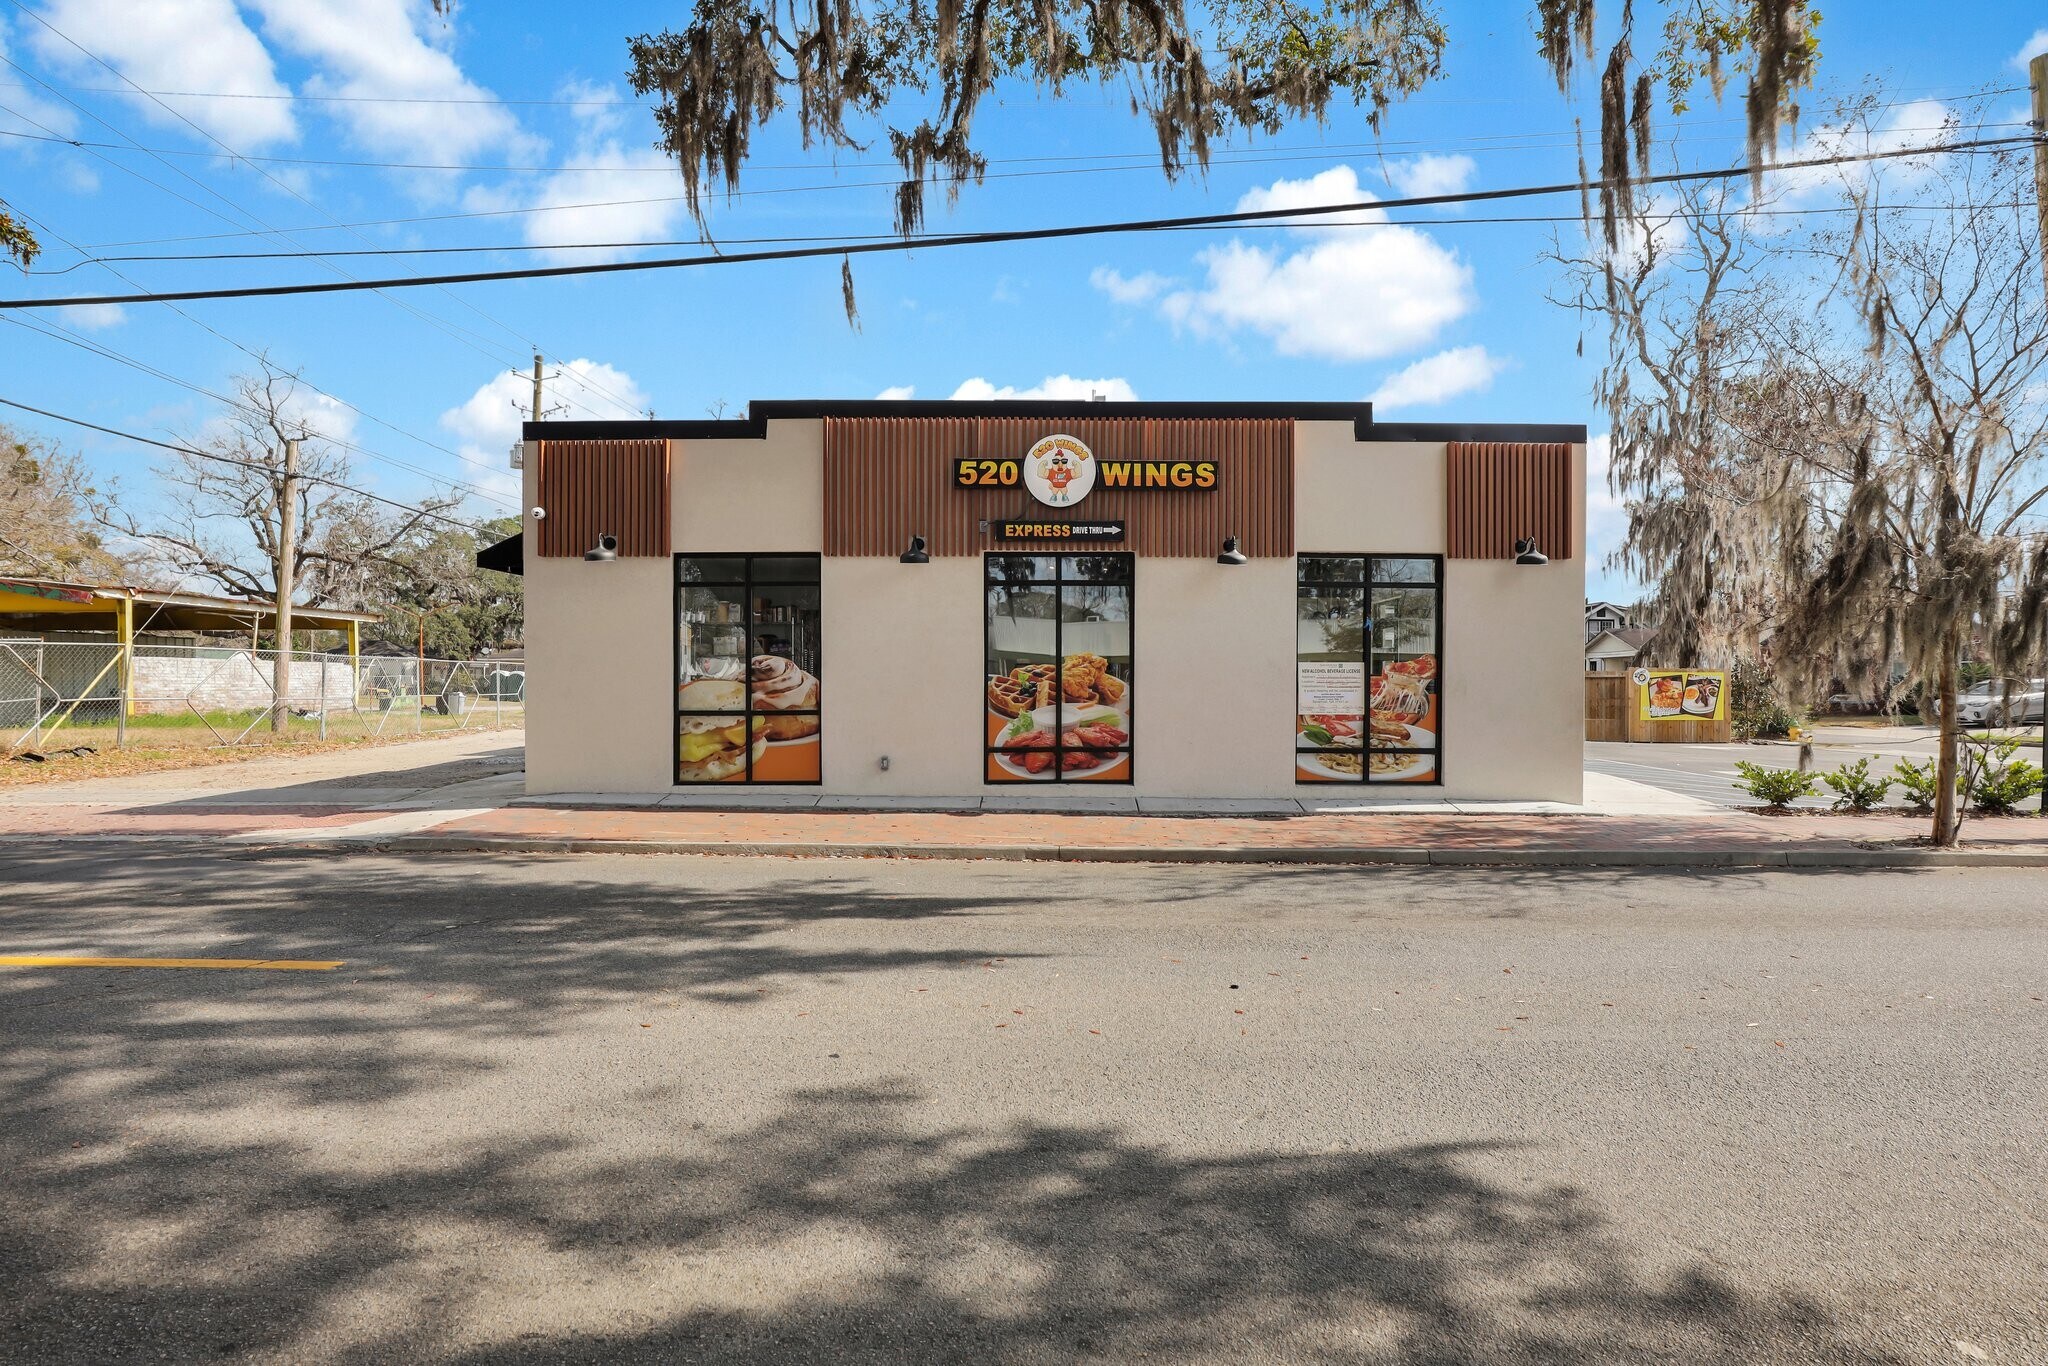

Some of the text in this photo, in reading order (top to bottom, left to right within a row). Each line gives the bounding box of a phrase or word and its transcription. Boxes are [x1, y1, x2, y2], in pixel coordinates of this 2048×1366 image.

[1032, 439, 1089, 461] 520 WINGS
[958, 461, 1216, 487] 520 WINGS
[1005, 524, 1103, 537] EXPRESS DRIVE THRU
